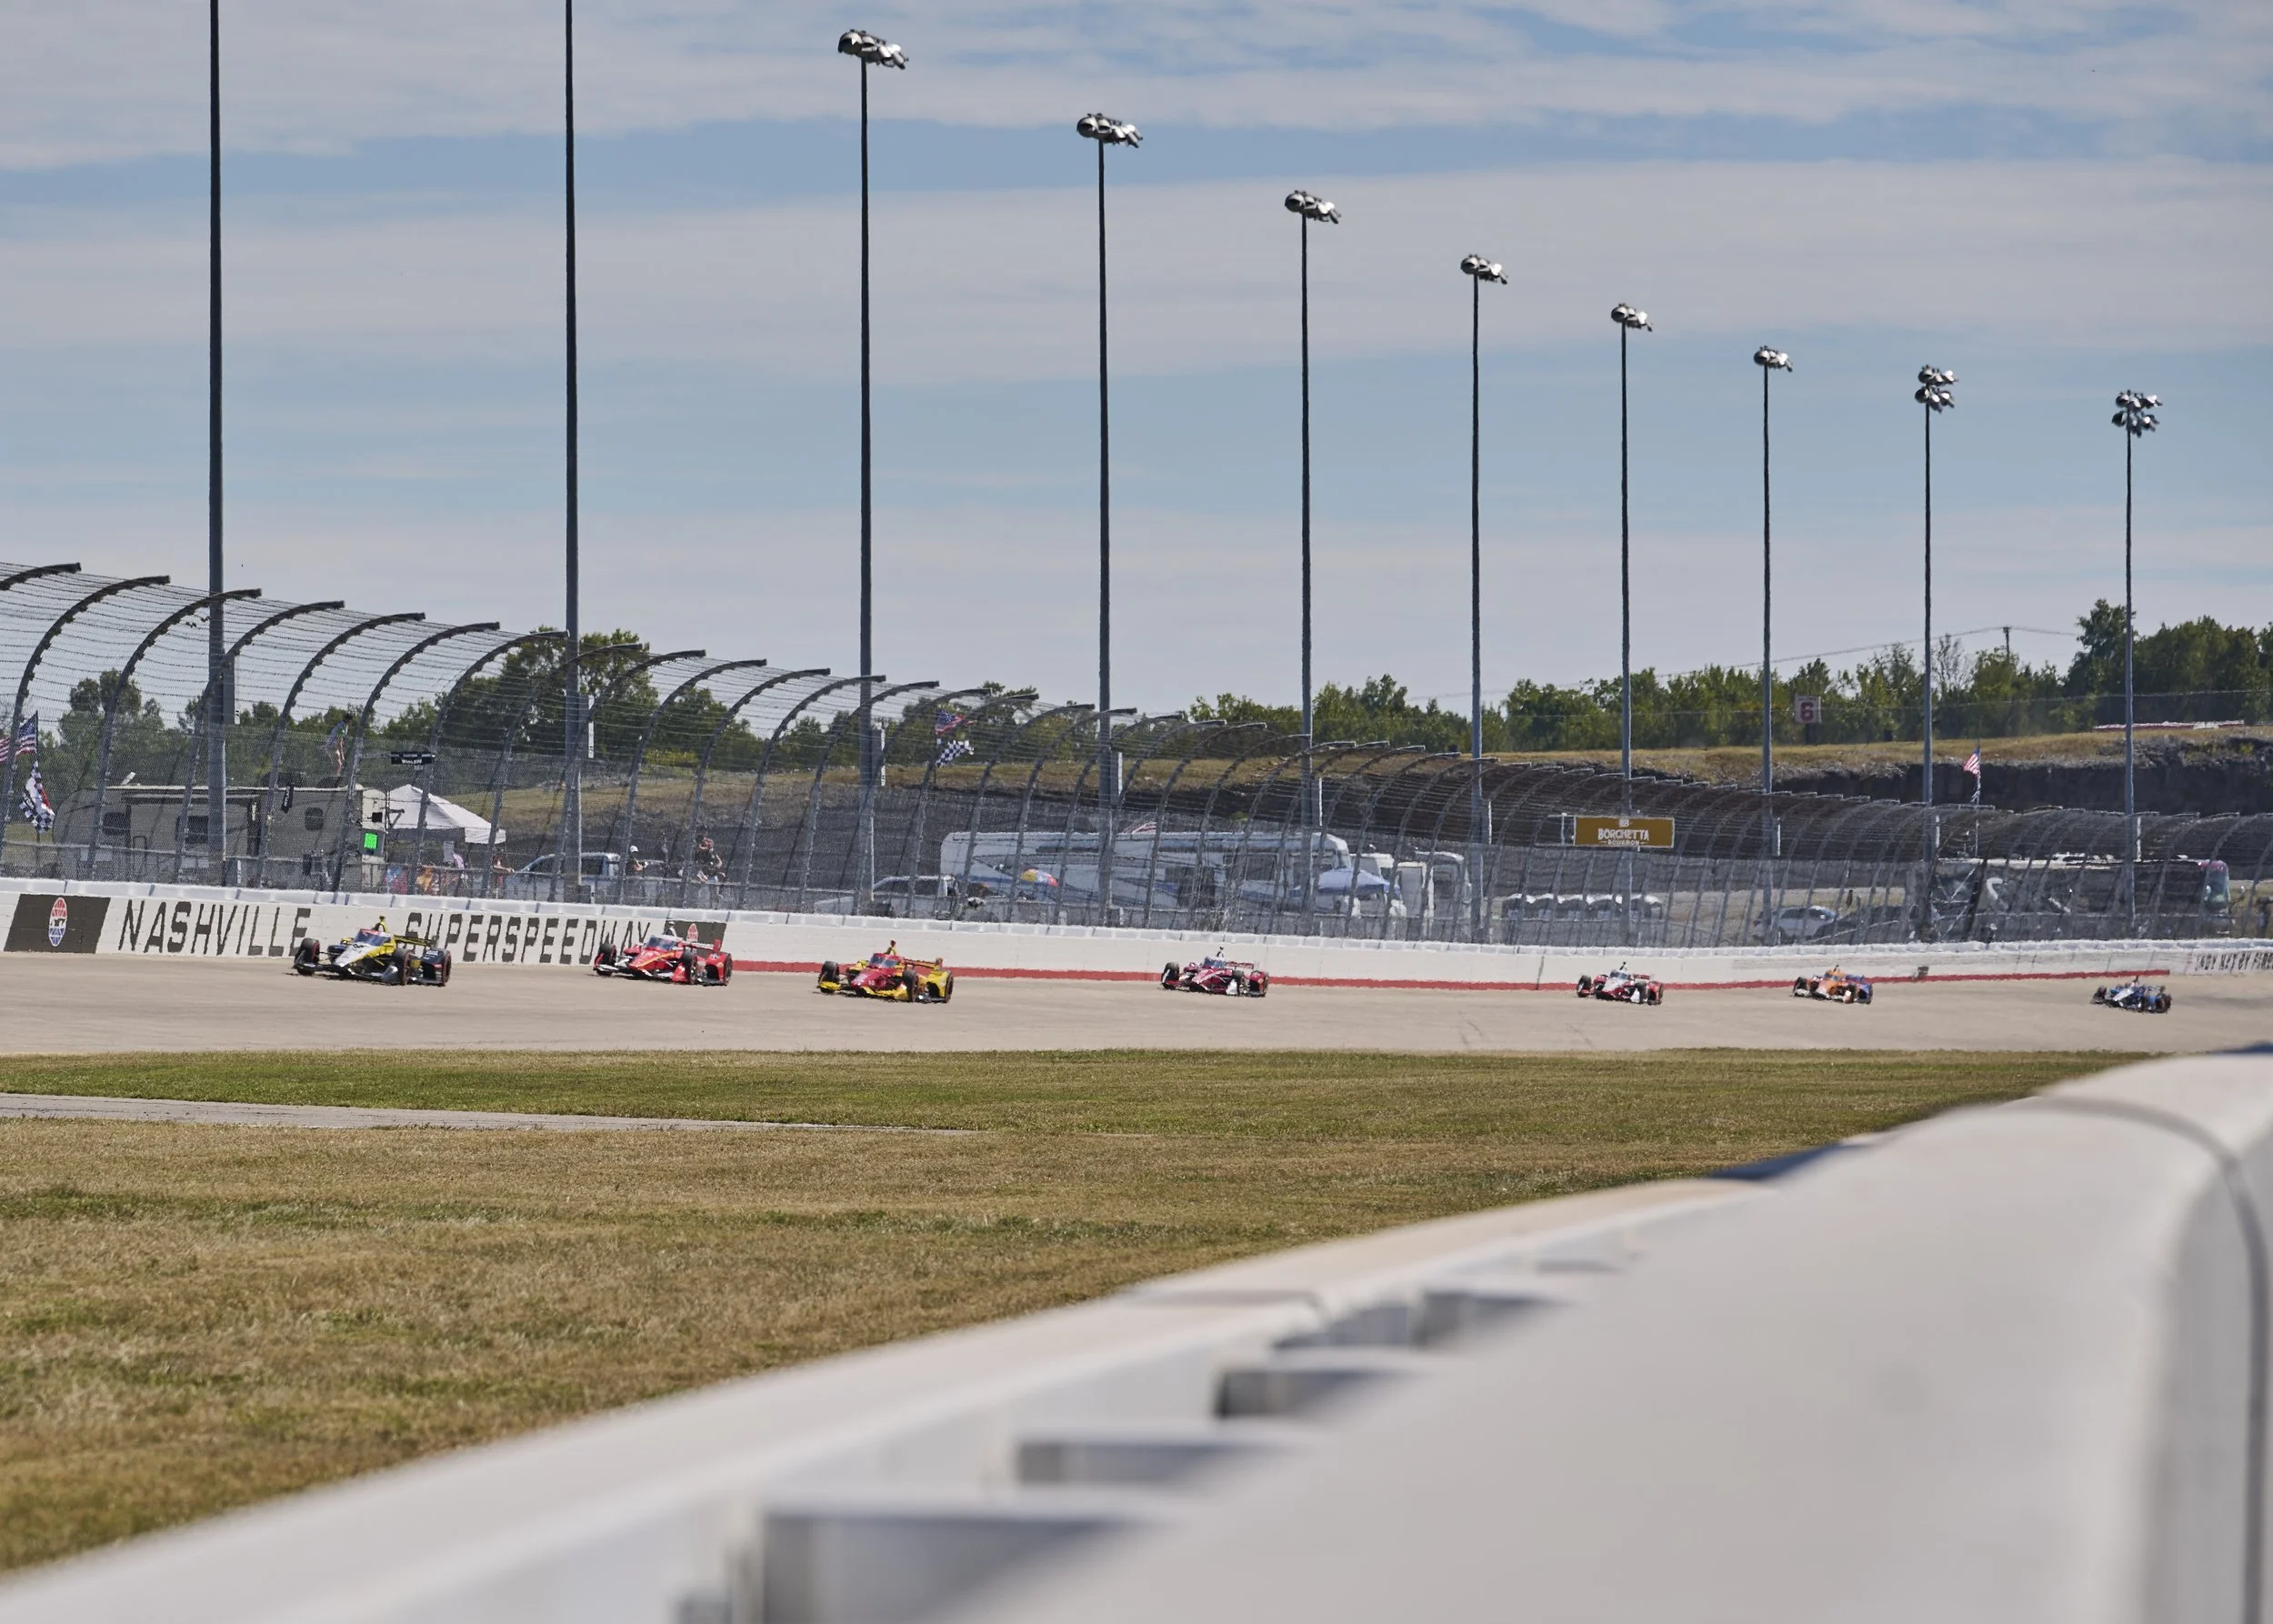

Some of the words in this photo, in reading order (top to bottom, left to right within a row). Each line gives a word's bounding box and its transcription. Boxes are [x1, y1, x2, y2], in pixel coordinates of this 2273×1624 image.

[1800, 702, 1814, 722] 6
[1597, 828, 1649, 841] BORCHETTA
[118, 899, 312, 957] NASHVILLE
